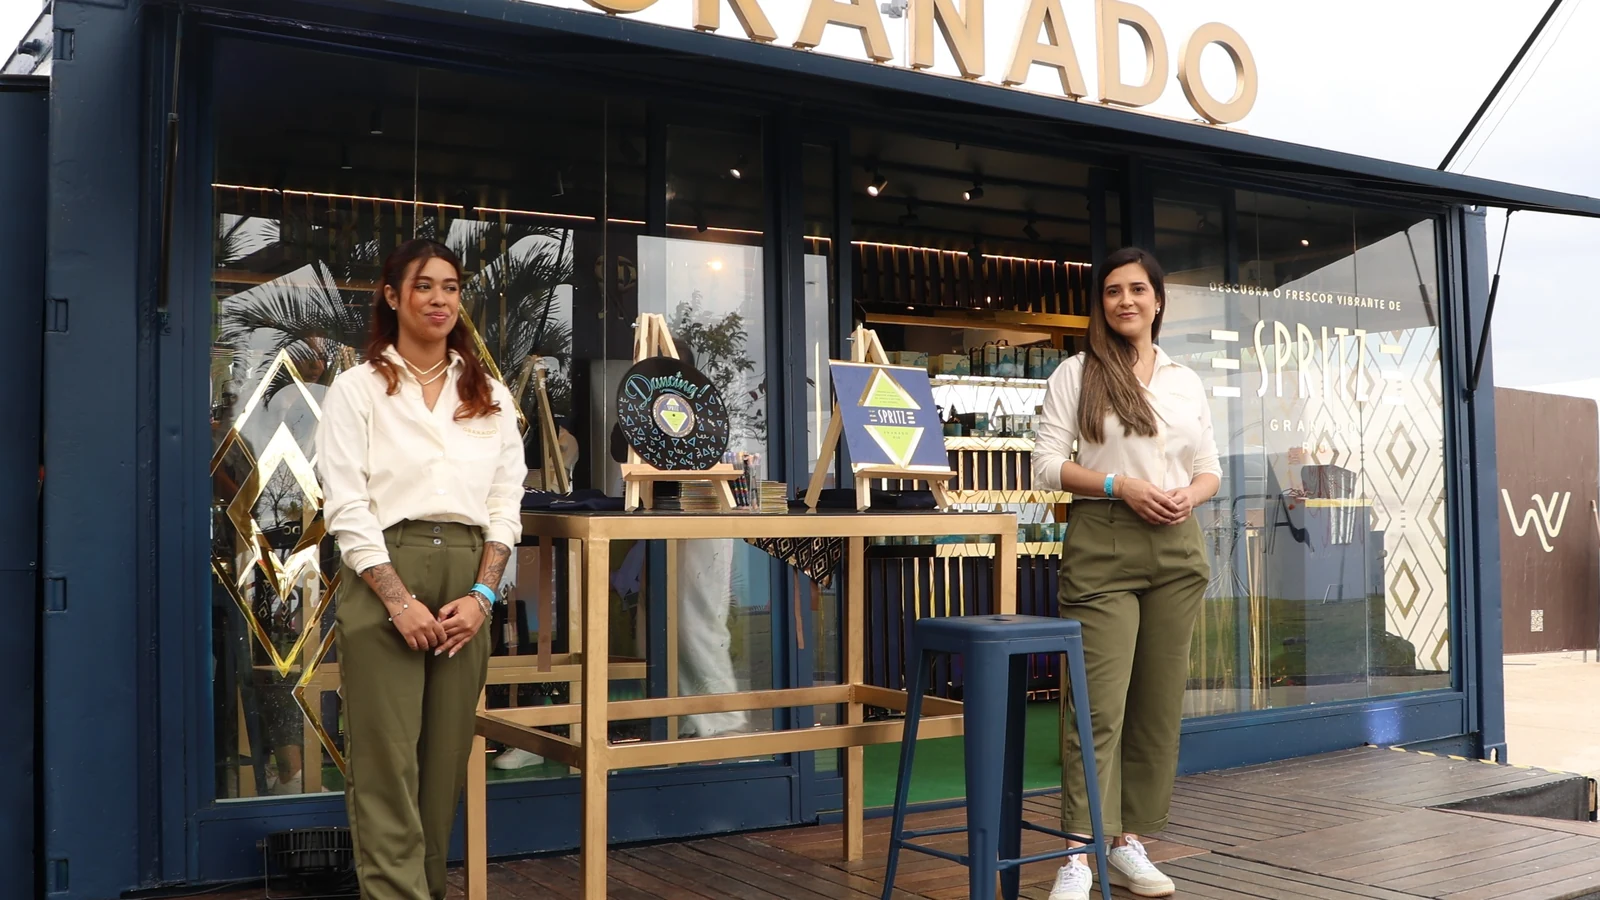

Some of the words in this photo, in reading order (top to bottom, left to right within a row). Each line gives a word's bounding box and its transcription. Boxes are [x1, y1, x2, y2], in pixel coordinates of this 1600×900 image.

[1209, 281, 1270, 297] DESCUBRA
[1273, 288, 1281, 298] O
[1285, 290, 1334, 305] FRESCOR
[1336, 295, 1385, 310] VIBRANTE
[1388, 301, 1401, 311] DE
[1253, 320, 1369, 402] SPRITZ
[624, 371, 711, 409] Dancing!
[877, 409, 907, 424] SPRITZ
[1269, 418, 1358, 433] GRANADO
